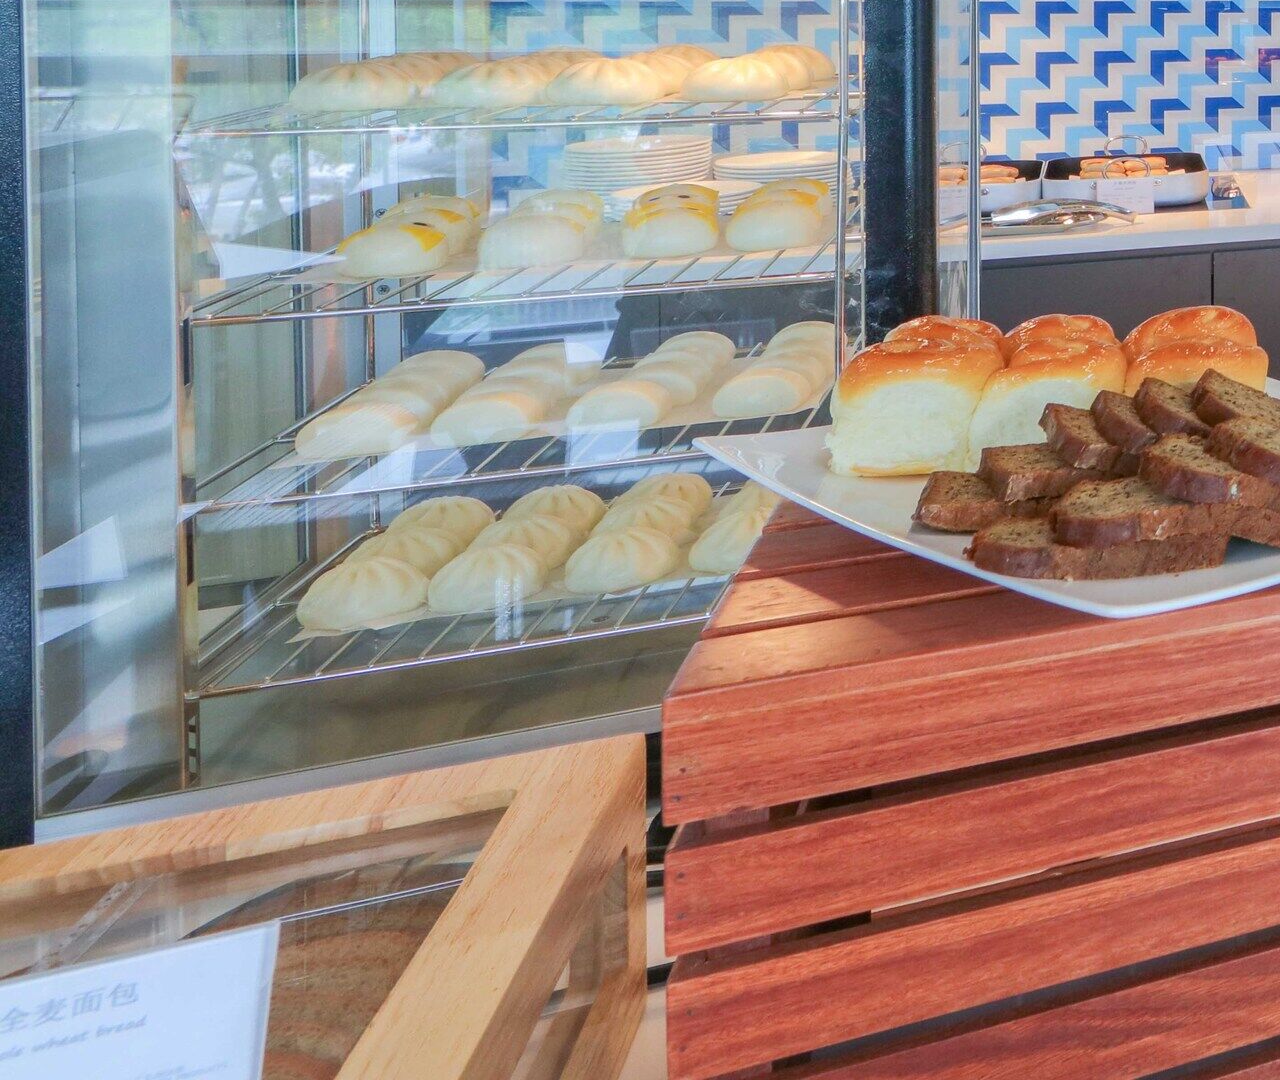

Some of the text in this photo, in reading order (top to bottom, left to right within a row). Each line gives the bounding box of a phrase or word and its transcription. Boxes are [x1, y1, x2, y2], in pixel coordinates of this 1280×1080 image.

[0, 982, 139, 1034] 全麦面包
[96, 1013, 148, 1038] bread
